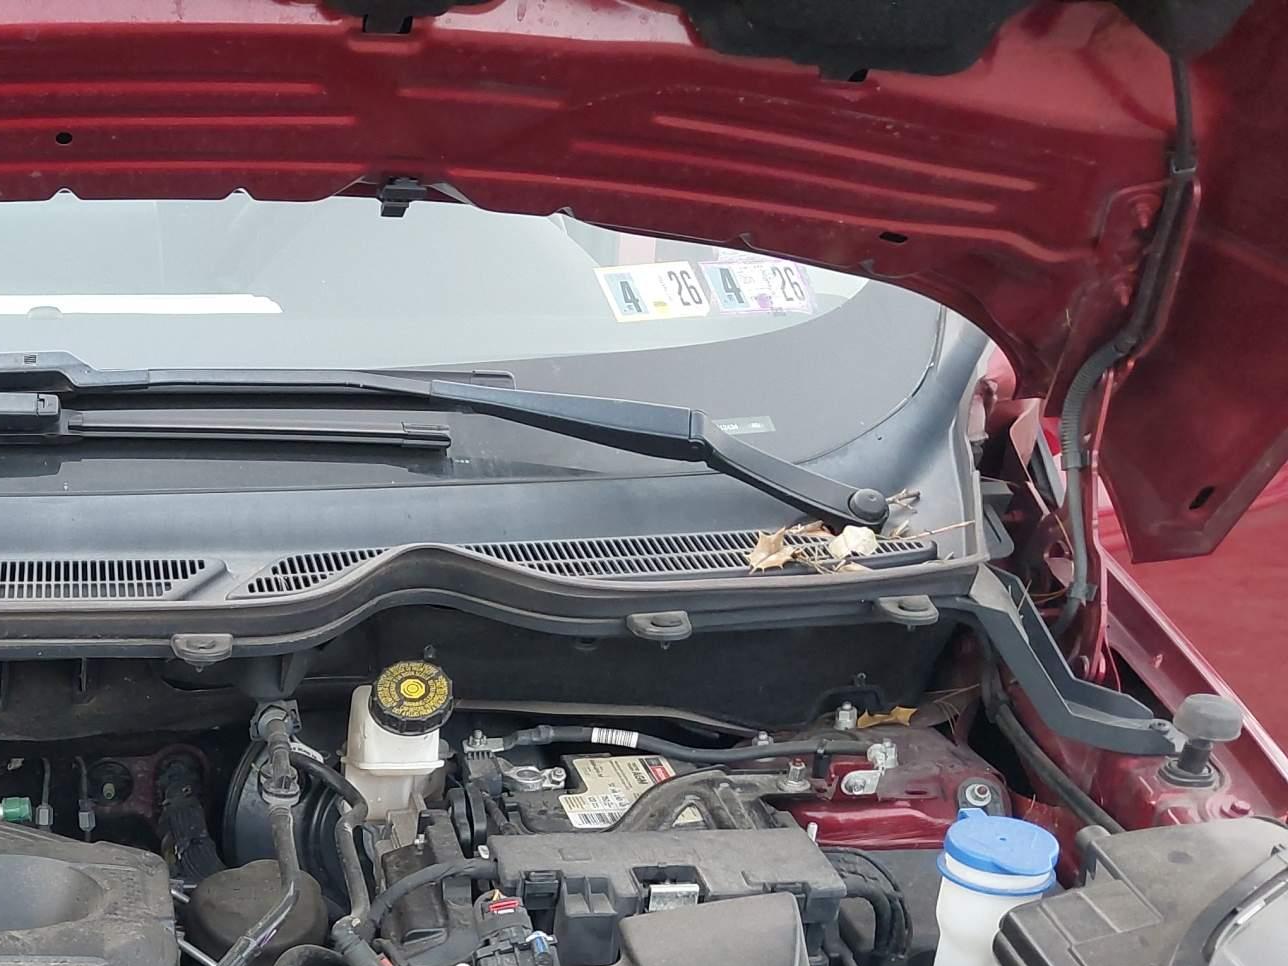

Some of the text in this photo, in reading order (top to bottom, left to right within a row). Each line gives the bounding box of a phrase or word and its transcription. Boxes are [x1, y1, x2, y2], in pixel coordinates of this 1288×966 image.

[620, 270, 703, 313] 4 26
[719, 268, 744, 304] 4
[771, 266, 806, 301] 26
